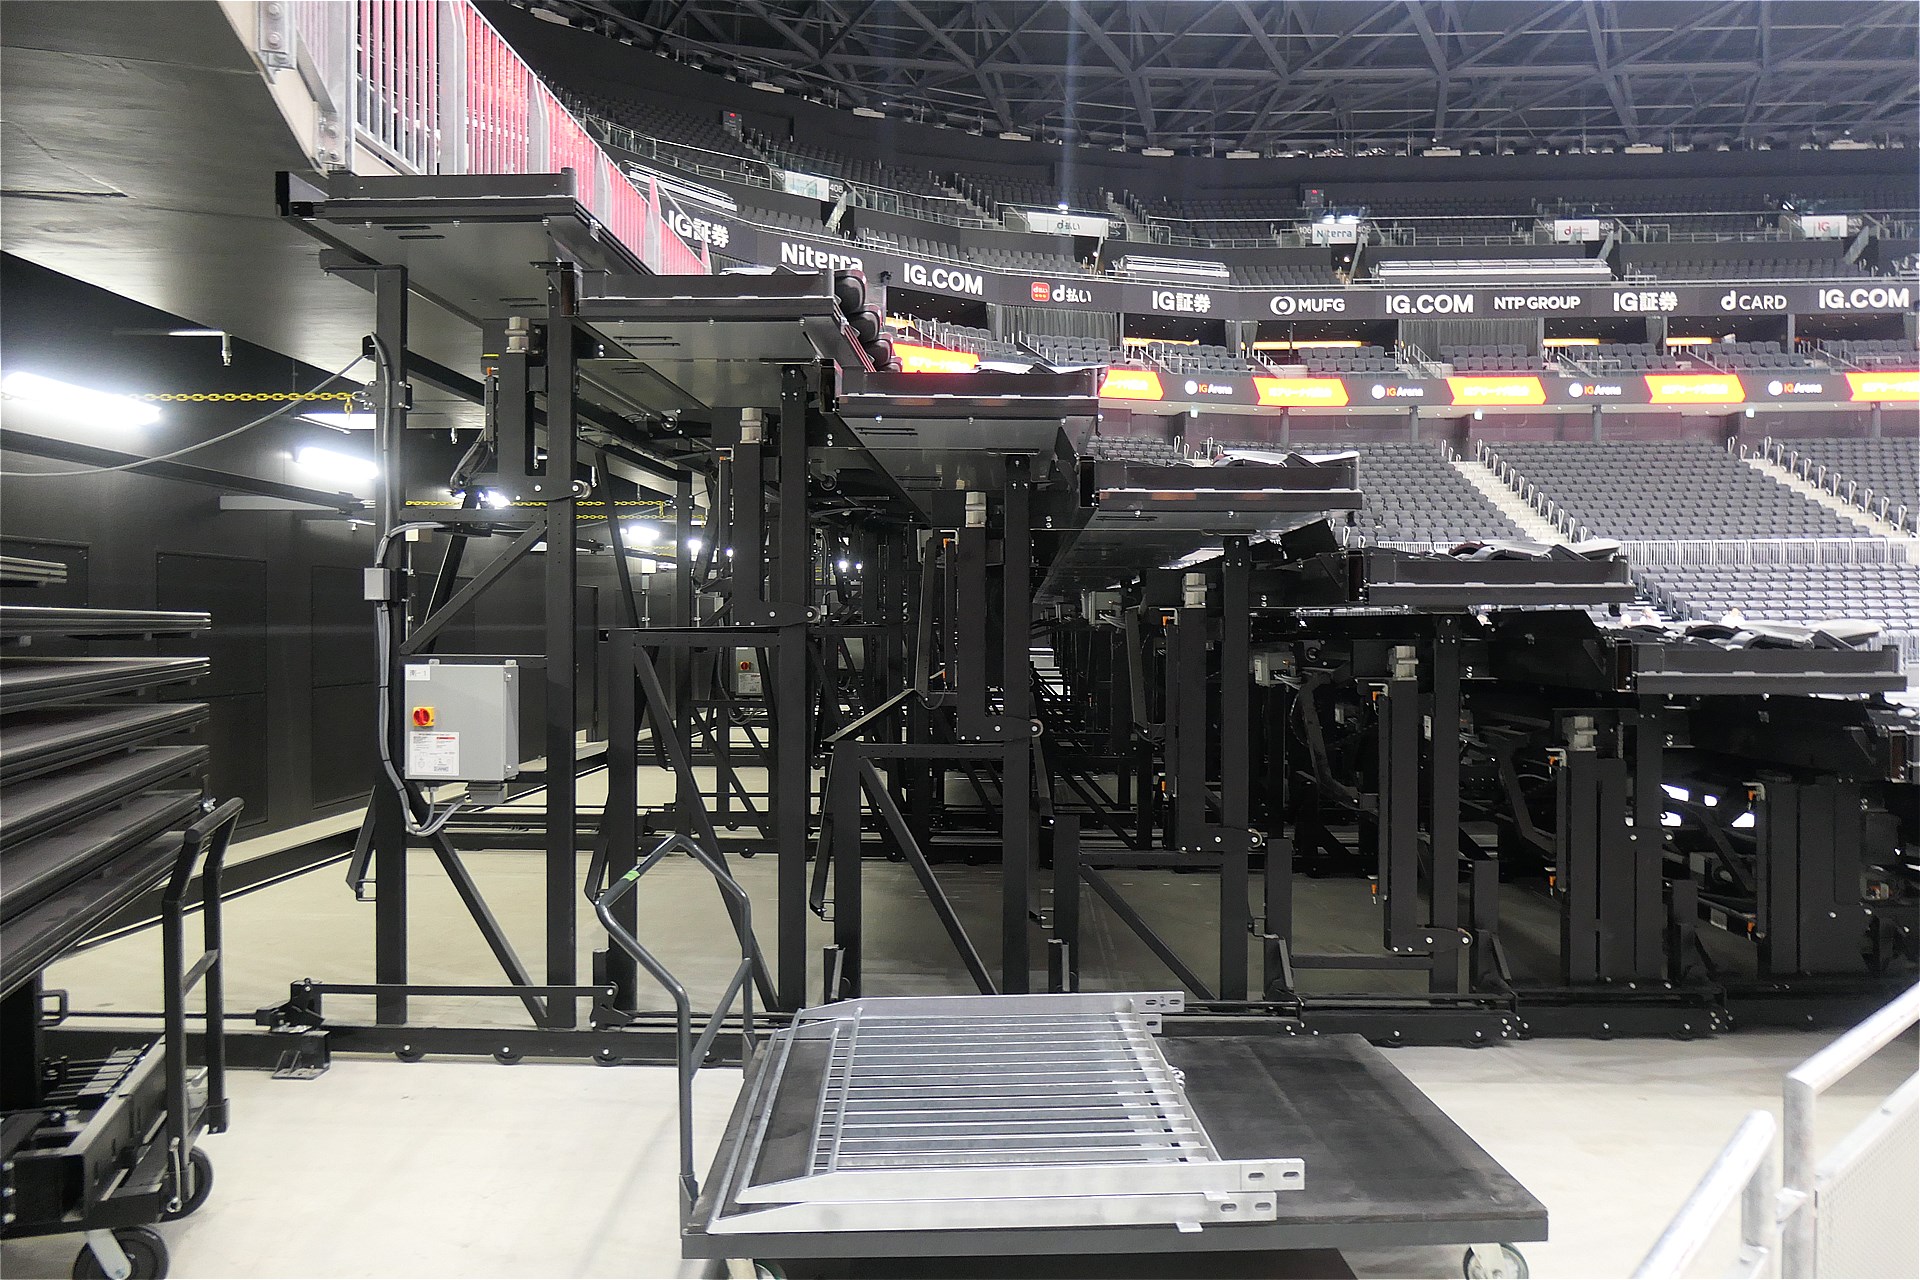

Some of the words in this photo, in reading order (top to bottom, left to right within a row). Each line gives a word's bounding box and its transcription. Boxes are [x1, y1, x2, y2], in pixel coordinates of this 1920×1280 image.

[1316, 229, 1353, 238] Nterra
[781, 241, 864, 271] Niterra
[903, 262, 983, 296] IG.COM
[1052, 284, 1092, 303] d払い
[1152, 290, 1212, 313] IG証券
[1613, 291, 1678, 312] IG証券
[1818, 287, 1910, 309] IG.COM
[1298, 298, 1346, 313] MUFG
[1385, 294, 1474, 314] IG.COM
[1494, 296, 1525, 310] NTP
[1526, 296, 1581, 310] GROUP
[1198, 383, 1208, 394] IG
[1386, 387, 1397, 397] IG
[1584, 385, 1594, 396] IG
[1783, 383, 1794, 394] IG
